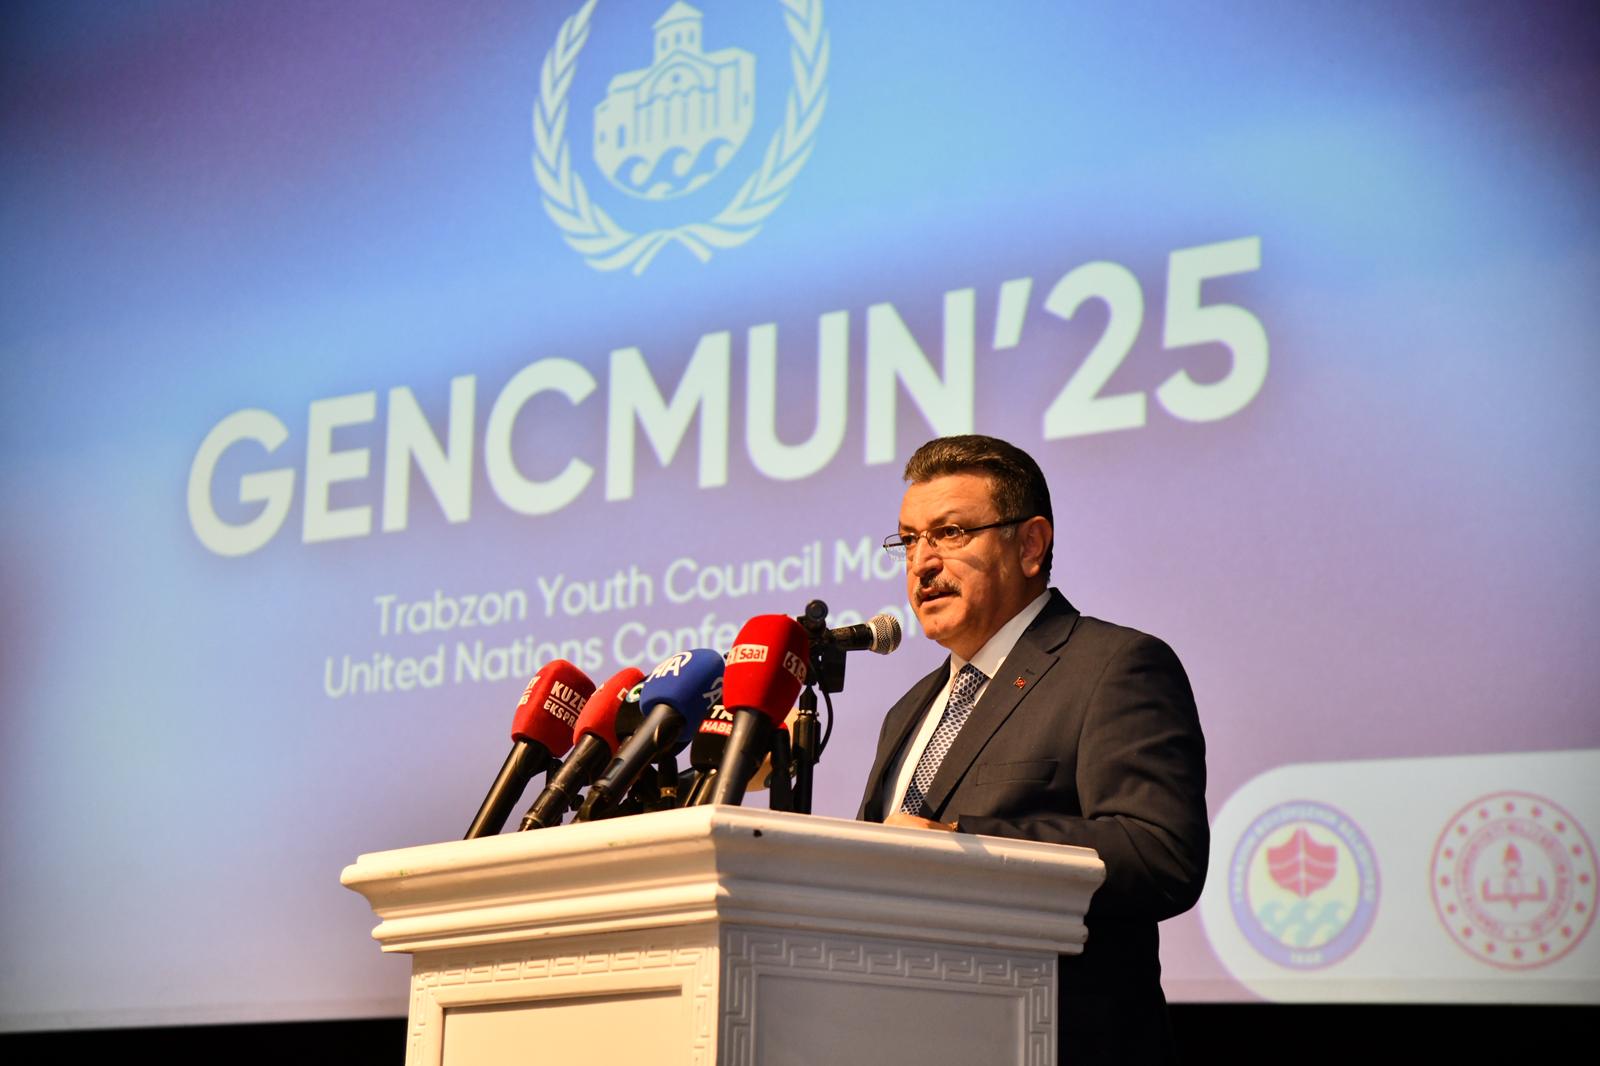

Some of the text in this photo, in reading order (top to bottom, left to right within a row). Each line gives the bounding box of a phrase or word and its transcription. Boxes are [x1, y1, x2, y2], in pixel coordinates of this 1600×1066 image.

[187, 236, 1269, 557] GENCMUN'25
[374, 535, 907, 636] Trabzon Youth Council Mo
[323, 643, 445, 699] United
[455, 634, 604, 683] Nations
[543, 699, 577, 729] EKSPR
[550, 681, 587, 711] KUZE
[700, 721, 733, 735] HABE
